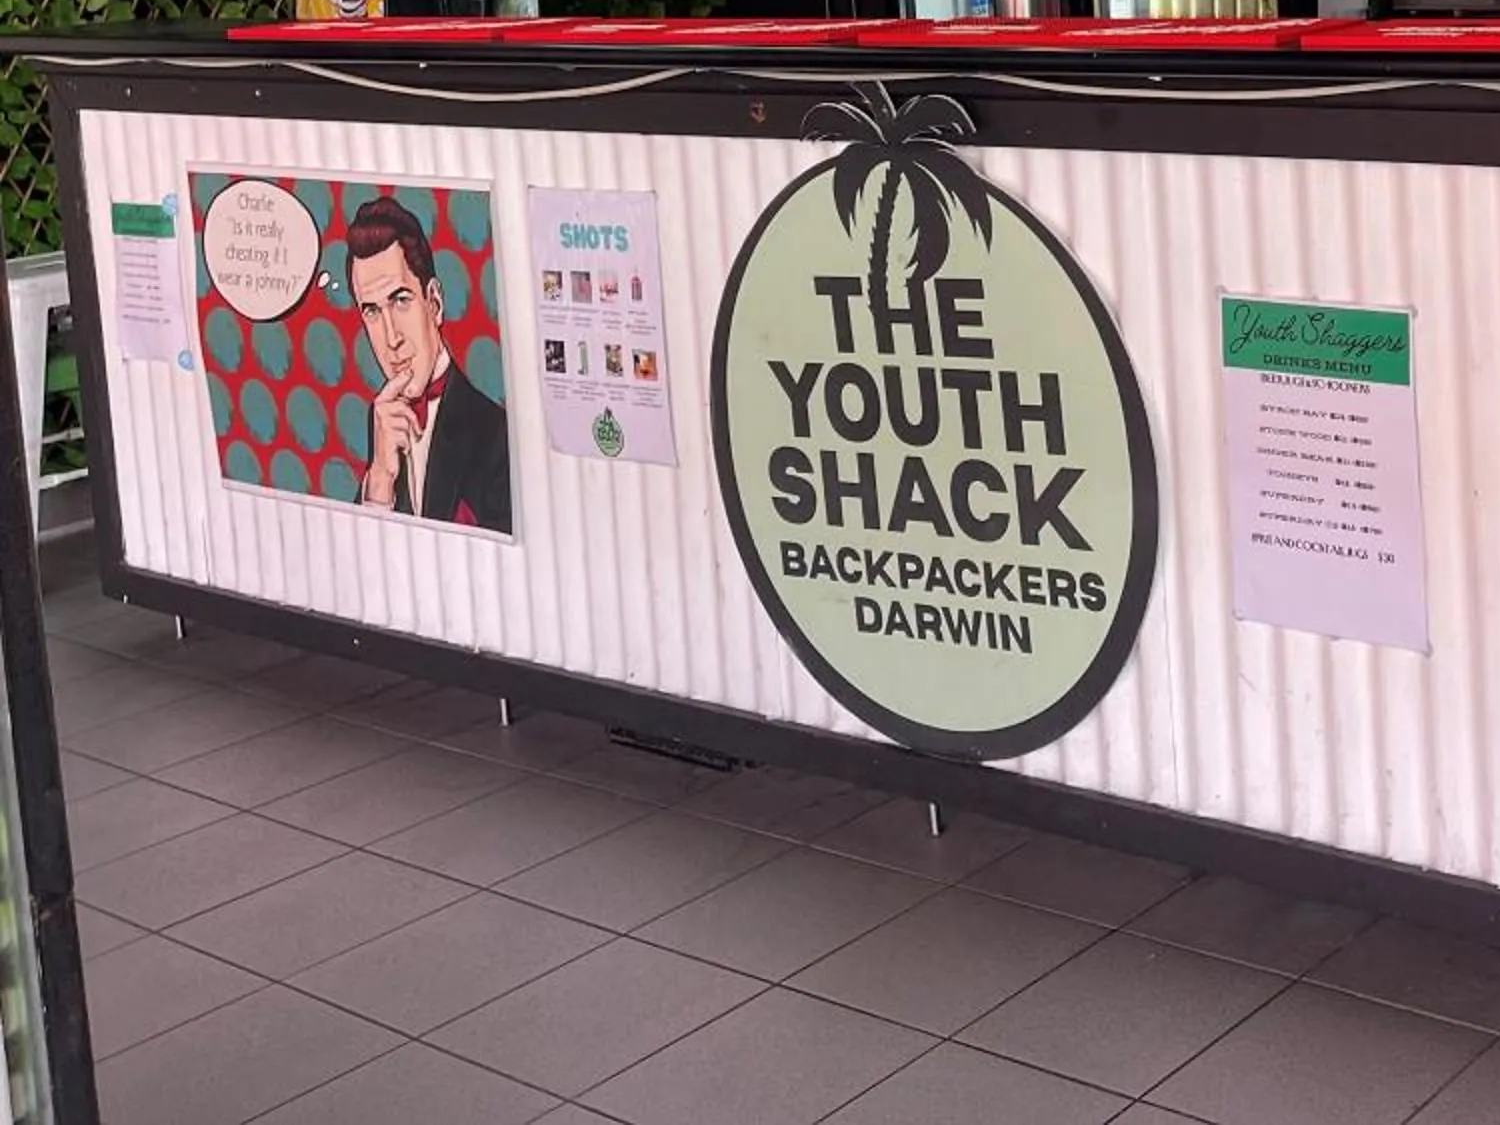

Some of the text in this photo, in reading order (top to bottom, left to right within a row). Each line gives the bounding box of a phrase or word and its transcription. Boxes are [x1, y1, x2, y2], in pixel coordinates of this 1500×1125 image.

[560, 222, 629, 252] SHOTS
[813, 275, 995, 359] THE
[1229, 304, 1406, 357] Youth Shaggers
[1263, 354, 1372, 375] DRINKS MENU
[767, 360, 1067, 456] YOUTH
[768, 445, 1094, 552] SHACK
[779, 540, 1108, 612] BACKPACKERS
[854, 596, 1033, 654] DARWIN
